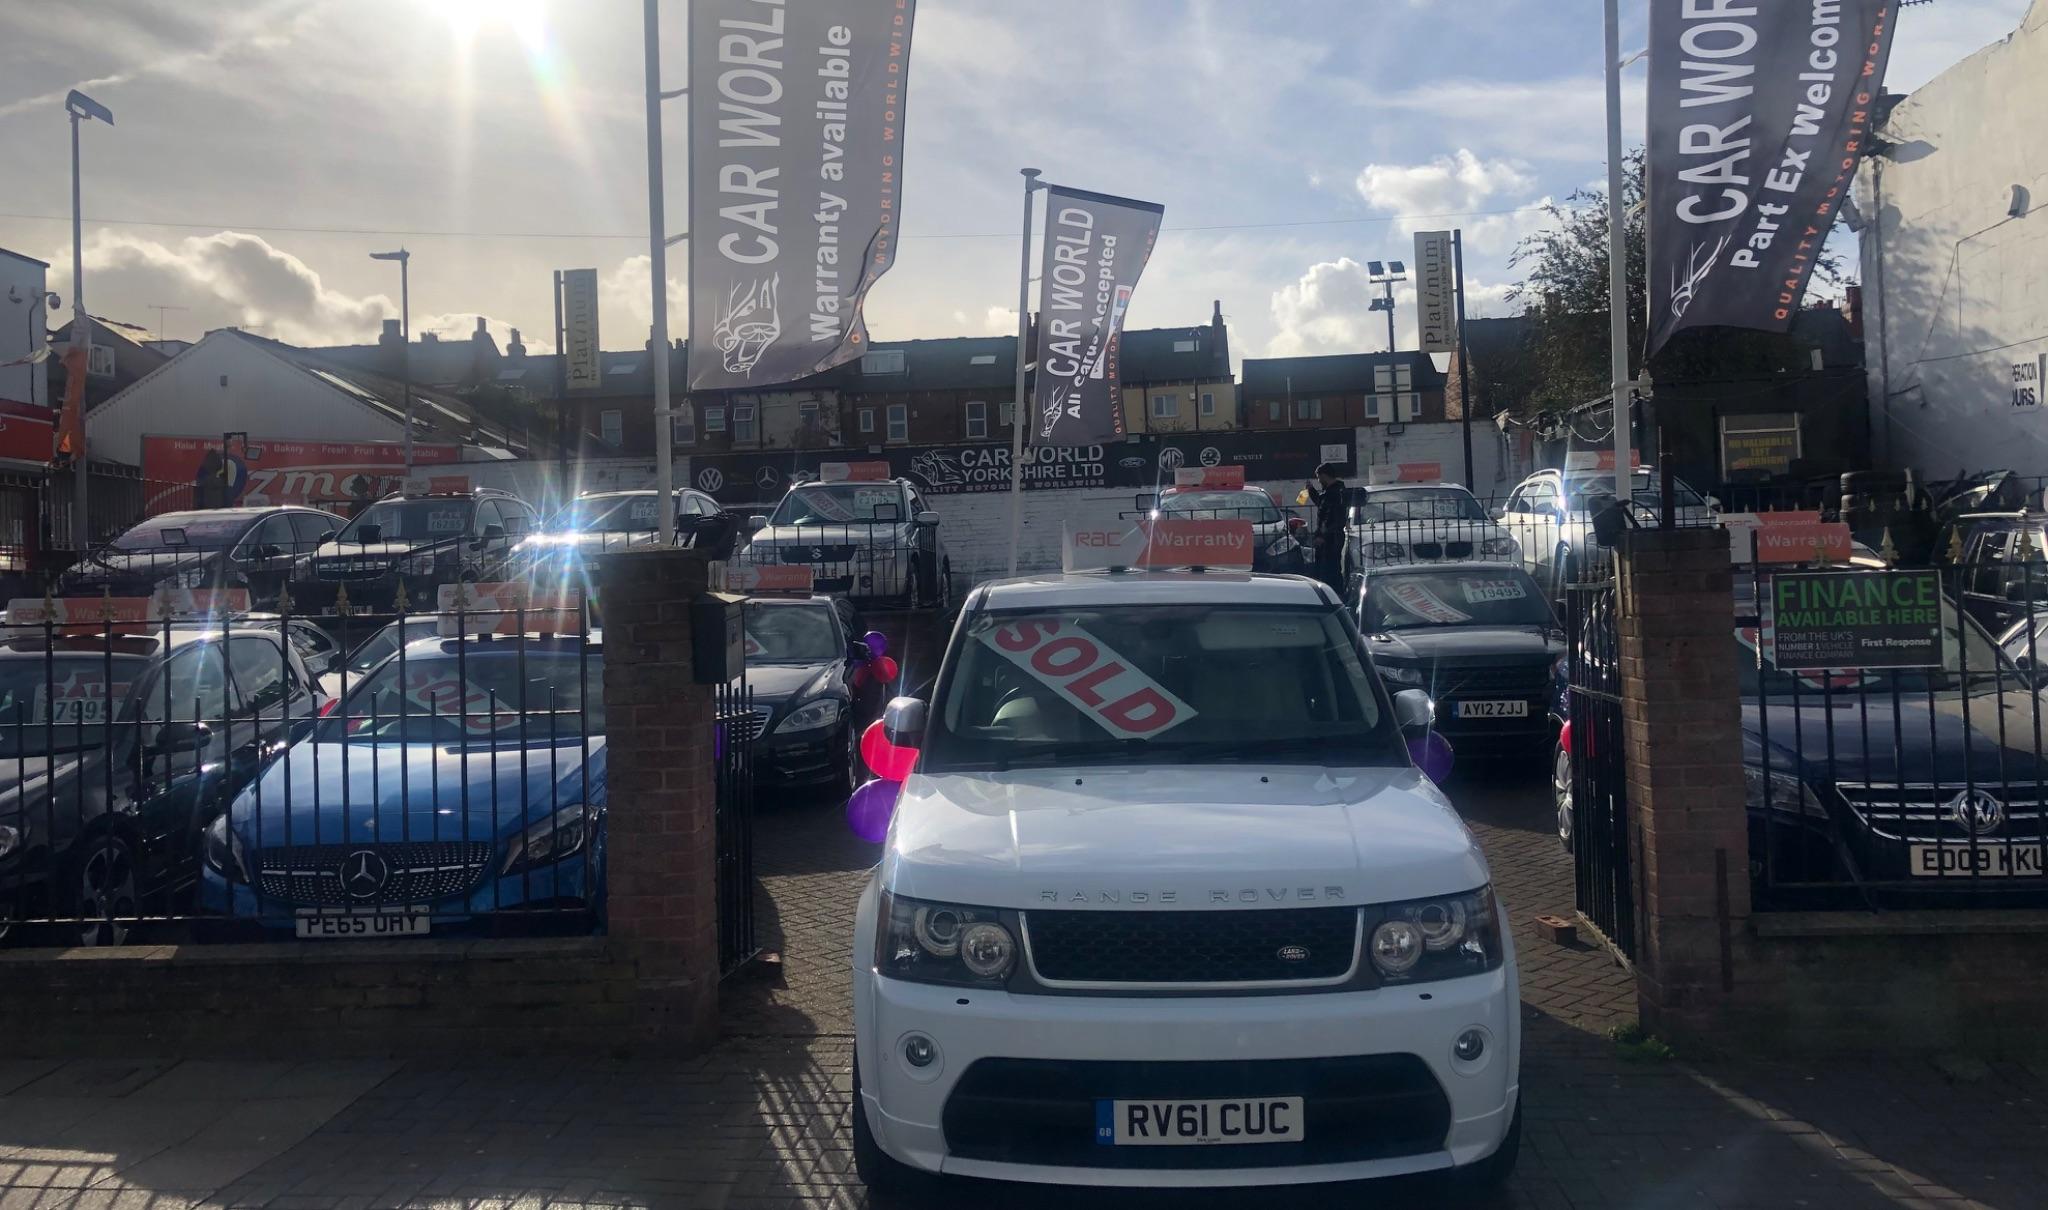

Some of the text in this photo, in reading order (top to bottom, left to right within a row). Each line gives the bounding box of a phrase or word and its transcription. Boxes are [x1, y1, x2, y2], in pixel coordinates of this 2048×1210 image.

[717, 0, 786, 264] CAR WORL
[1729, 0, 1841, 268] Part Ex Welcom
[1676, 114, 1752, 224] CAR
[808, 25, 852, 342] Warranty available
[875, 154, 893, 264] MOTORING
[1775, 225, 1818, 320] QUALITY
[1046, 207, 1094, 377] CAR WORLD
[1425, 240, 1443, 345] Platinum
[961, 449, 1011, 467] CAR
[1072, 463, 1105, 477] LTD
[1156, 532, 1246, 549] Warranty
[1778, 576, 1937, 610] FINANCE
[74, 607, 141, 621] Waanty
[1778, 608, 1938, 628] AVAILABLE HERE
[1778, 632, 1805, 642] FROM
[1808, 631, 1829, 641] THE
[1778, 643, 1814, 651] NUMBER
[1861, 636, 1933, 650] First Response
[994, 616, 1176, 733] SOLD
[1463, 702, 1524, 716] AY12 ZJJ
[1040, 886, 1345, 903] RANGE ROVER
[306, 914, 366, 934] PE65
[1128, 1102, 1290, 1138] RV61 CUC
